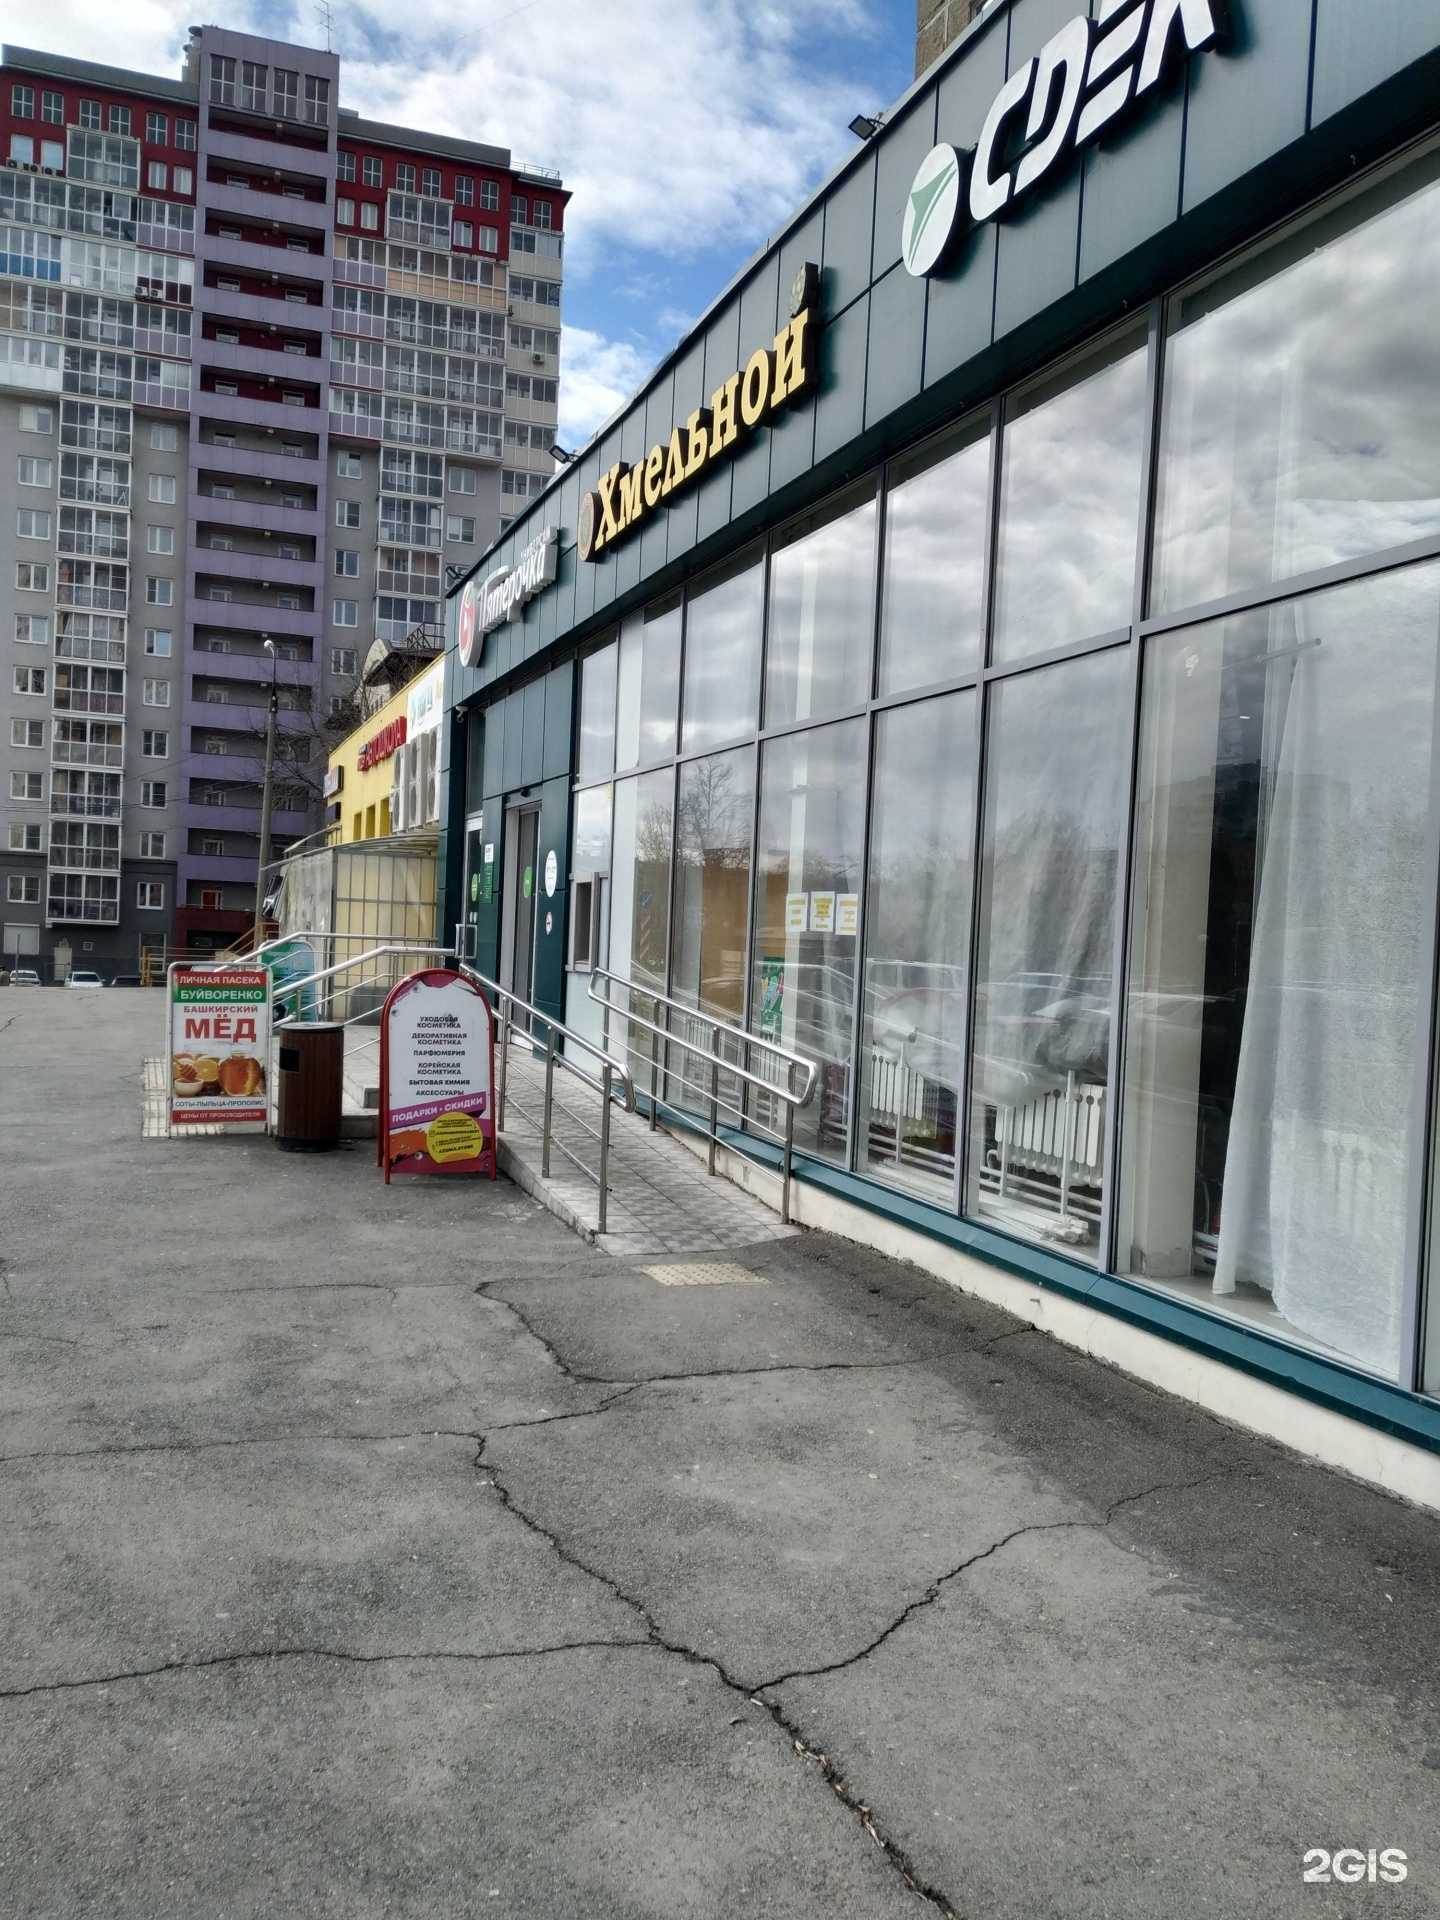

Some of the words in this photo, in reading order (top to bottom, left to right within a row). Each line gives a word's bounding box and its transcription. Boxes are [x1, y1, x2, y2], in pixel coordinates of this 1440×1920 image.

[180, 976, 220, 984] ЛИЧНАЯ
[222, 976, 261, 984] ПАСЕКА
[181, 988, 263, 1000] БУЙВОРЕНКО
[183, 1005, 258, 1013] БАШКИРСКИЙ
[185, 1013, 257, 1043] МЁД
[392, 1106, 438, 1122] ПОДАРКИ
[444, 1097, 483, 1112] СКИДКИ
